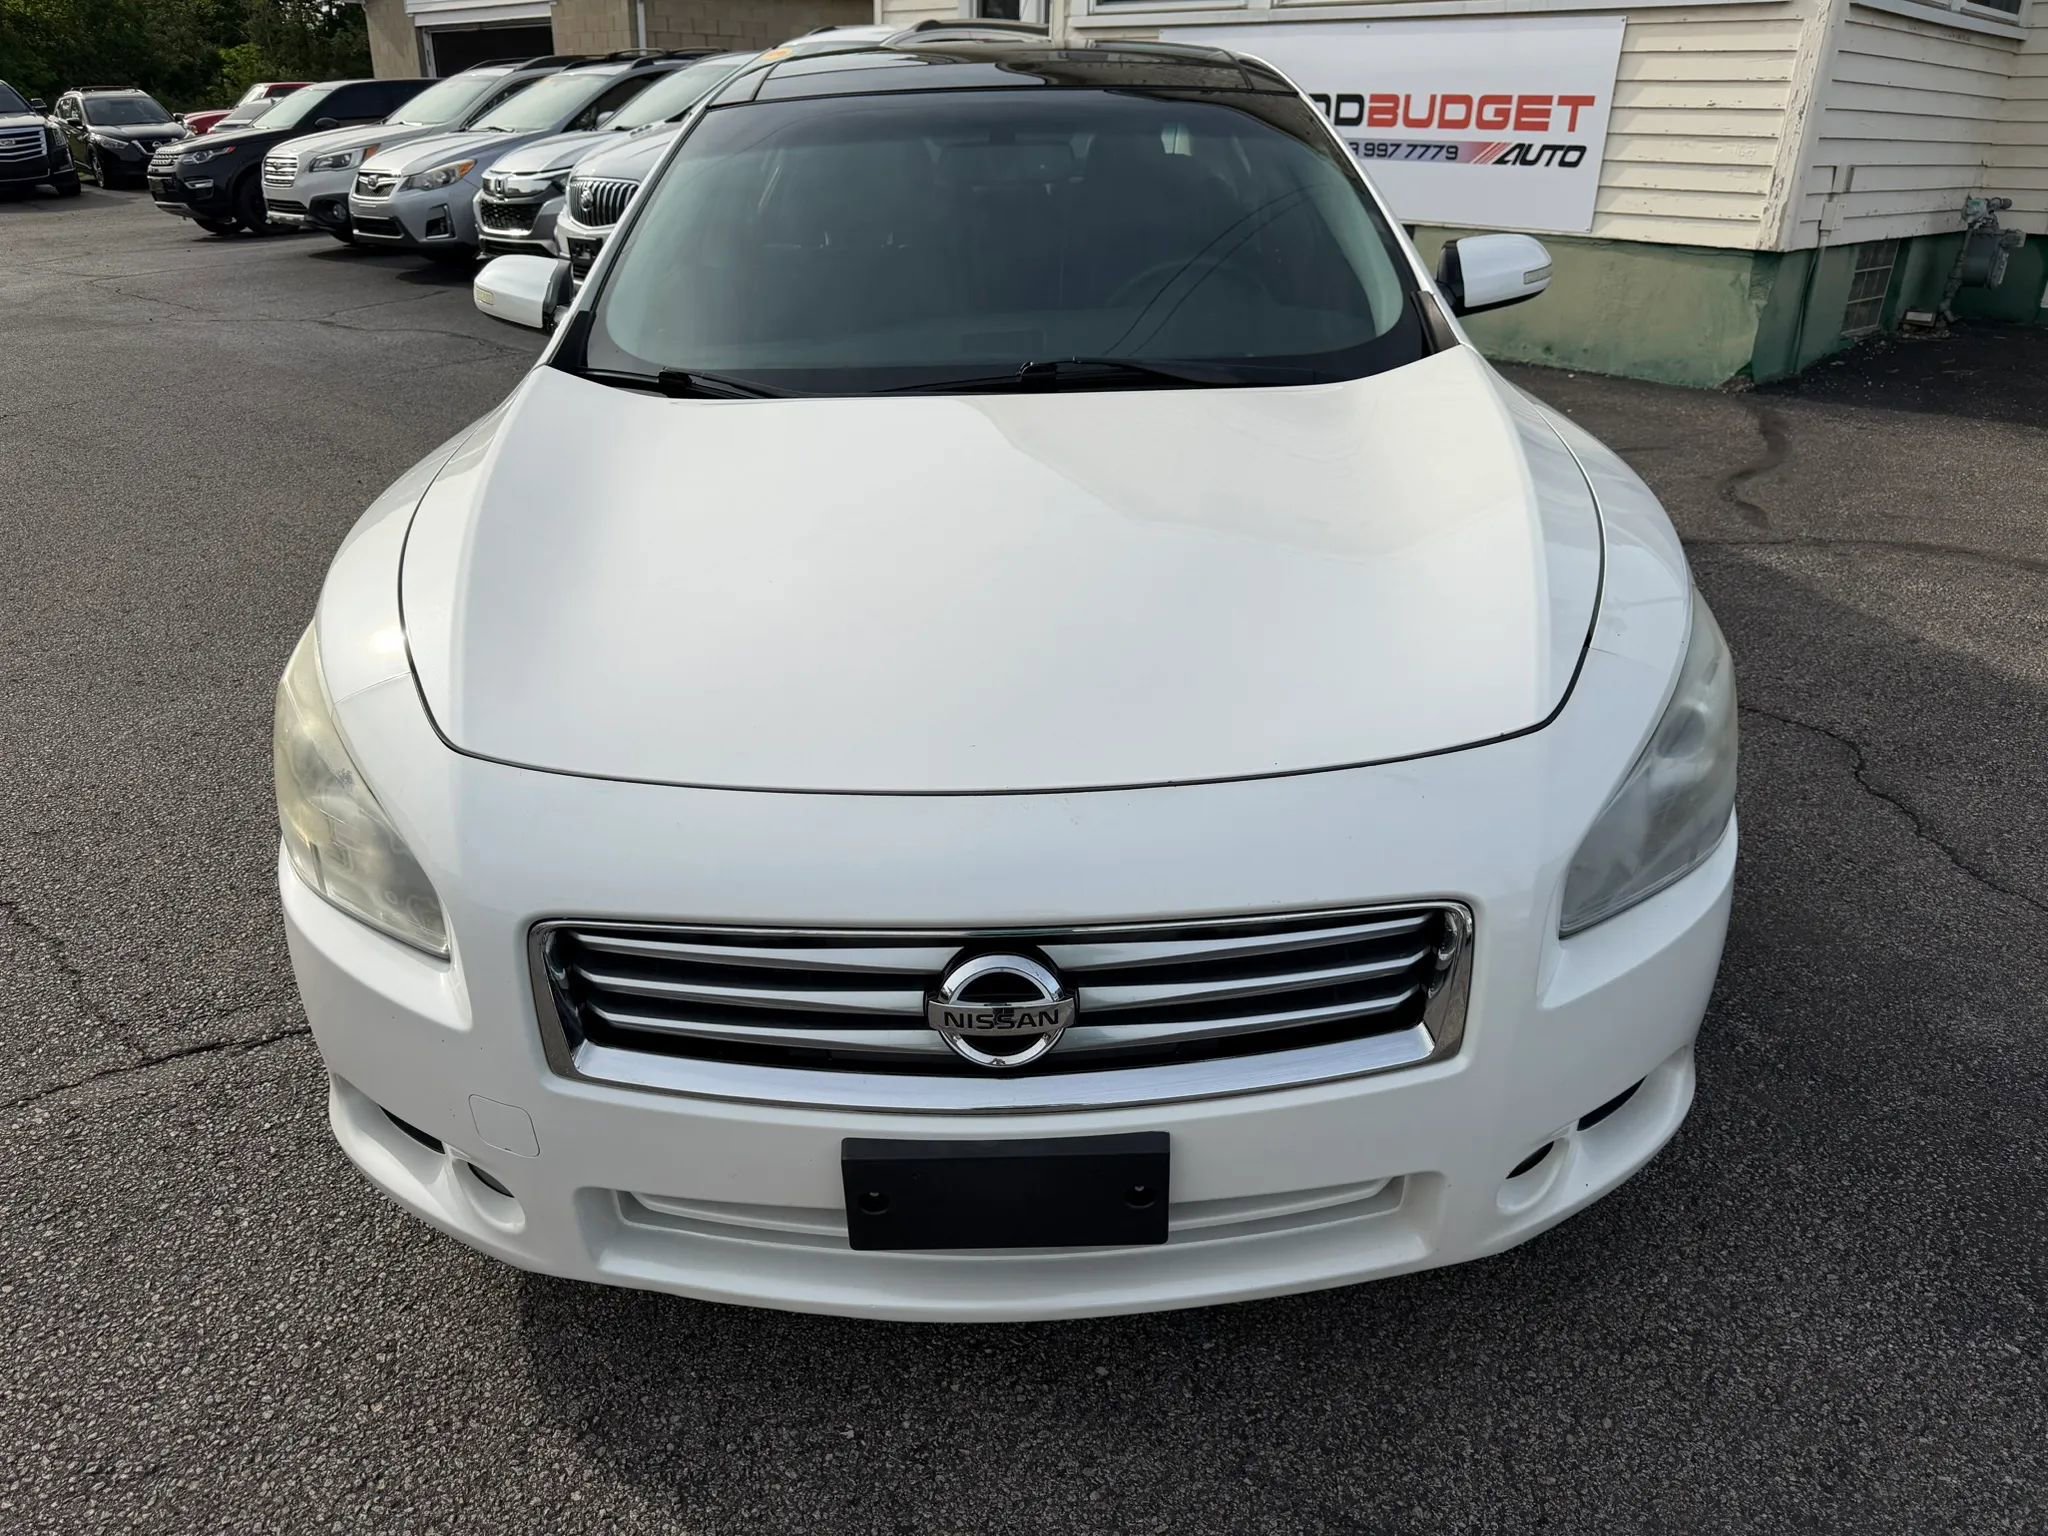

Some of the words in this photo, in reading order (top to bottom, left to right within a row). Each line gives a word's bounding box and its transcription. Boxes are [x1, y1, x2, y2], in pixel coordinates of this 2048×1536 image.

[1363, 142, 1402, 159] 997
[1404, 143, 1459, 161] 7779
[1492, 142, 1588, 168] AUTO
[943, 1008, 1060, 1030] NISSAN
